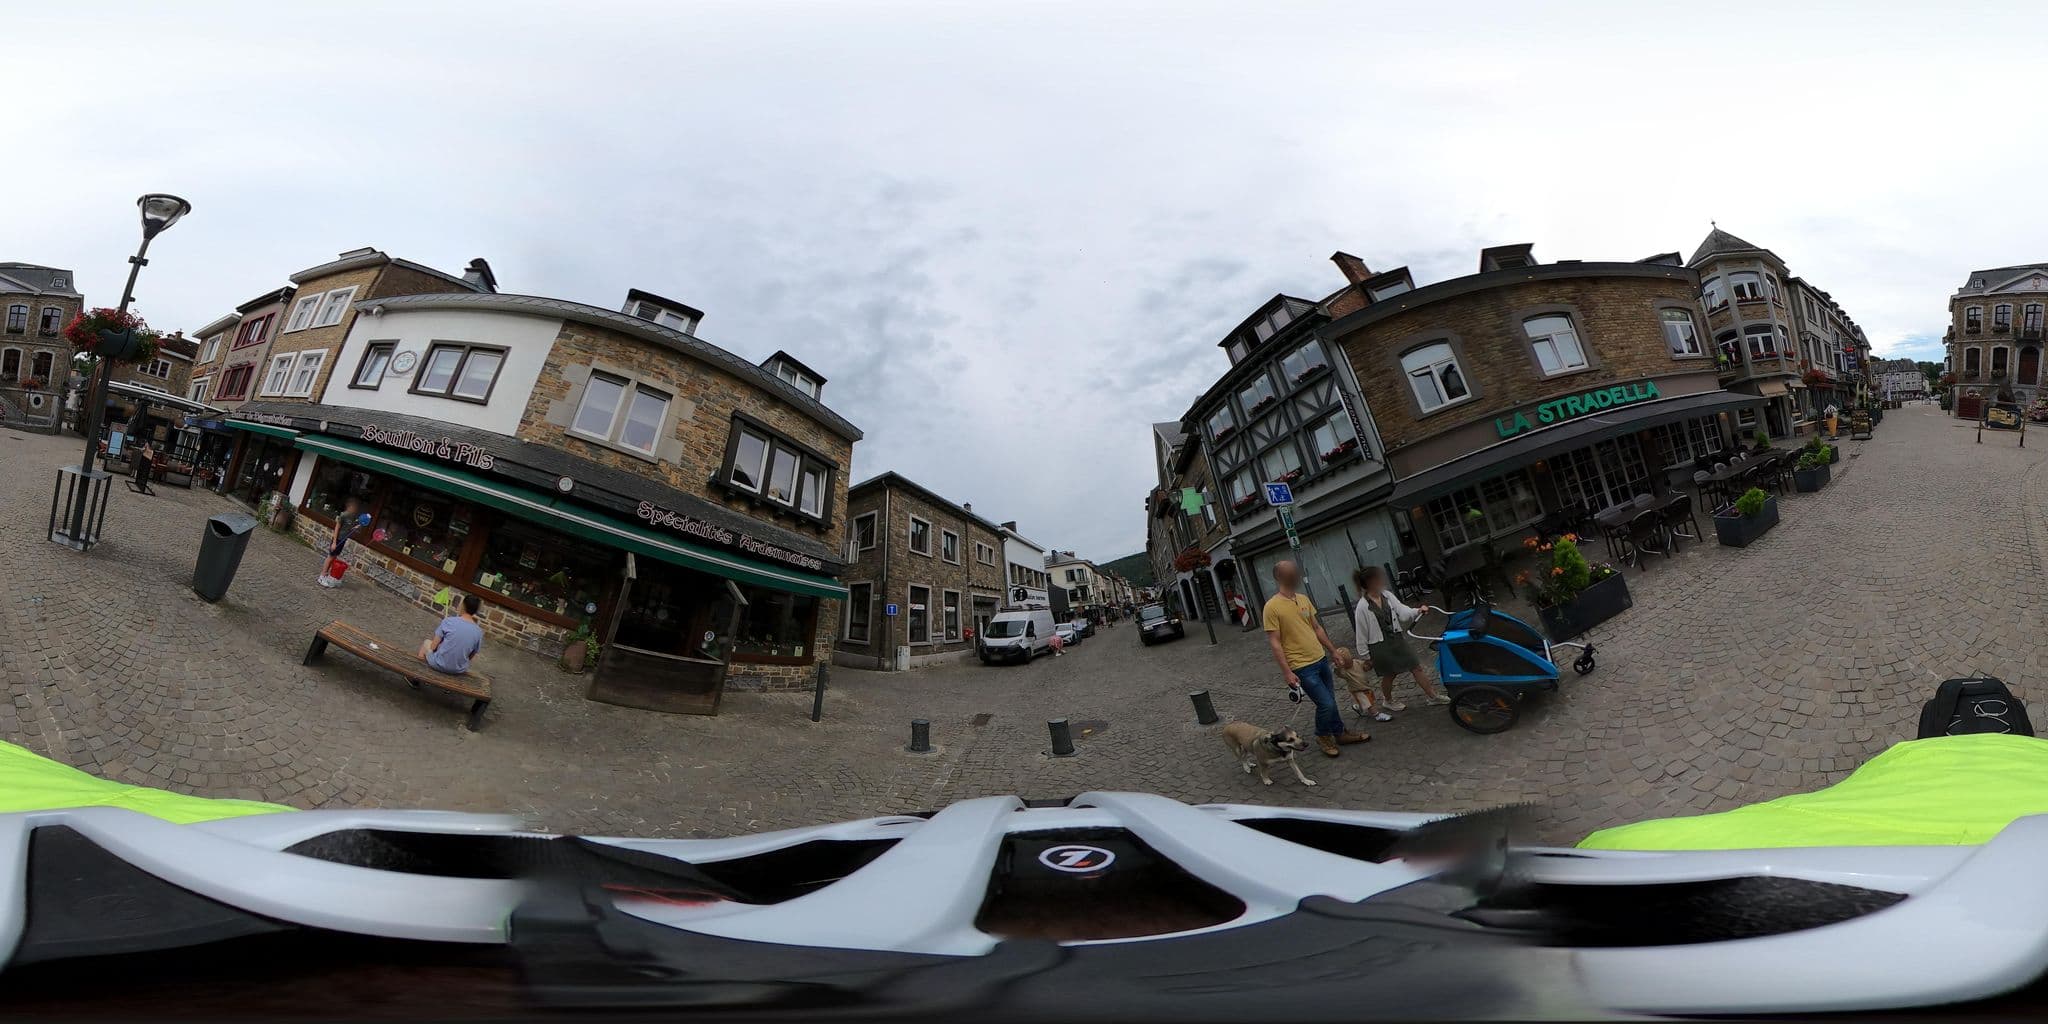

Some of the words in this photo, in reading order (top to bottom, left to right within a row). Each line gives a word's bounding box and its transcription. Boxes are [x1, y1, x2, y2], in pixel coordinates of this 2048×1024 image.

[1495, 411, 1532, 437] LA
[1536, 380, 1661, 423] STRADELLA
[361, 424, 434, 455] Bouillon
[436, 436, 451, 459] &
[453, 441, 494, 470] Fils
[637, 500, 733, 545] Spécialités
[739, 533, 822, 571] Ardennaises
